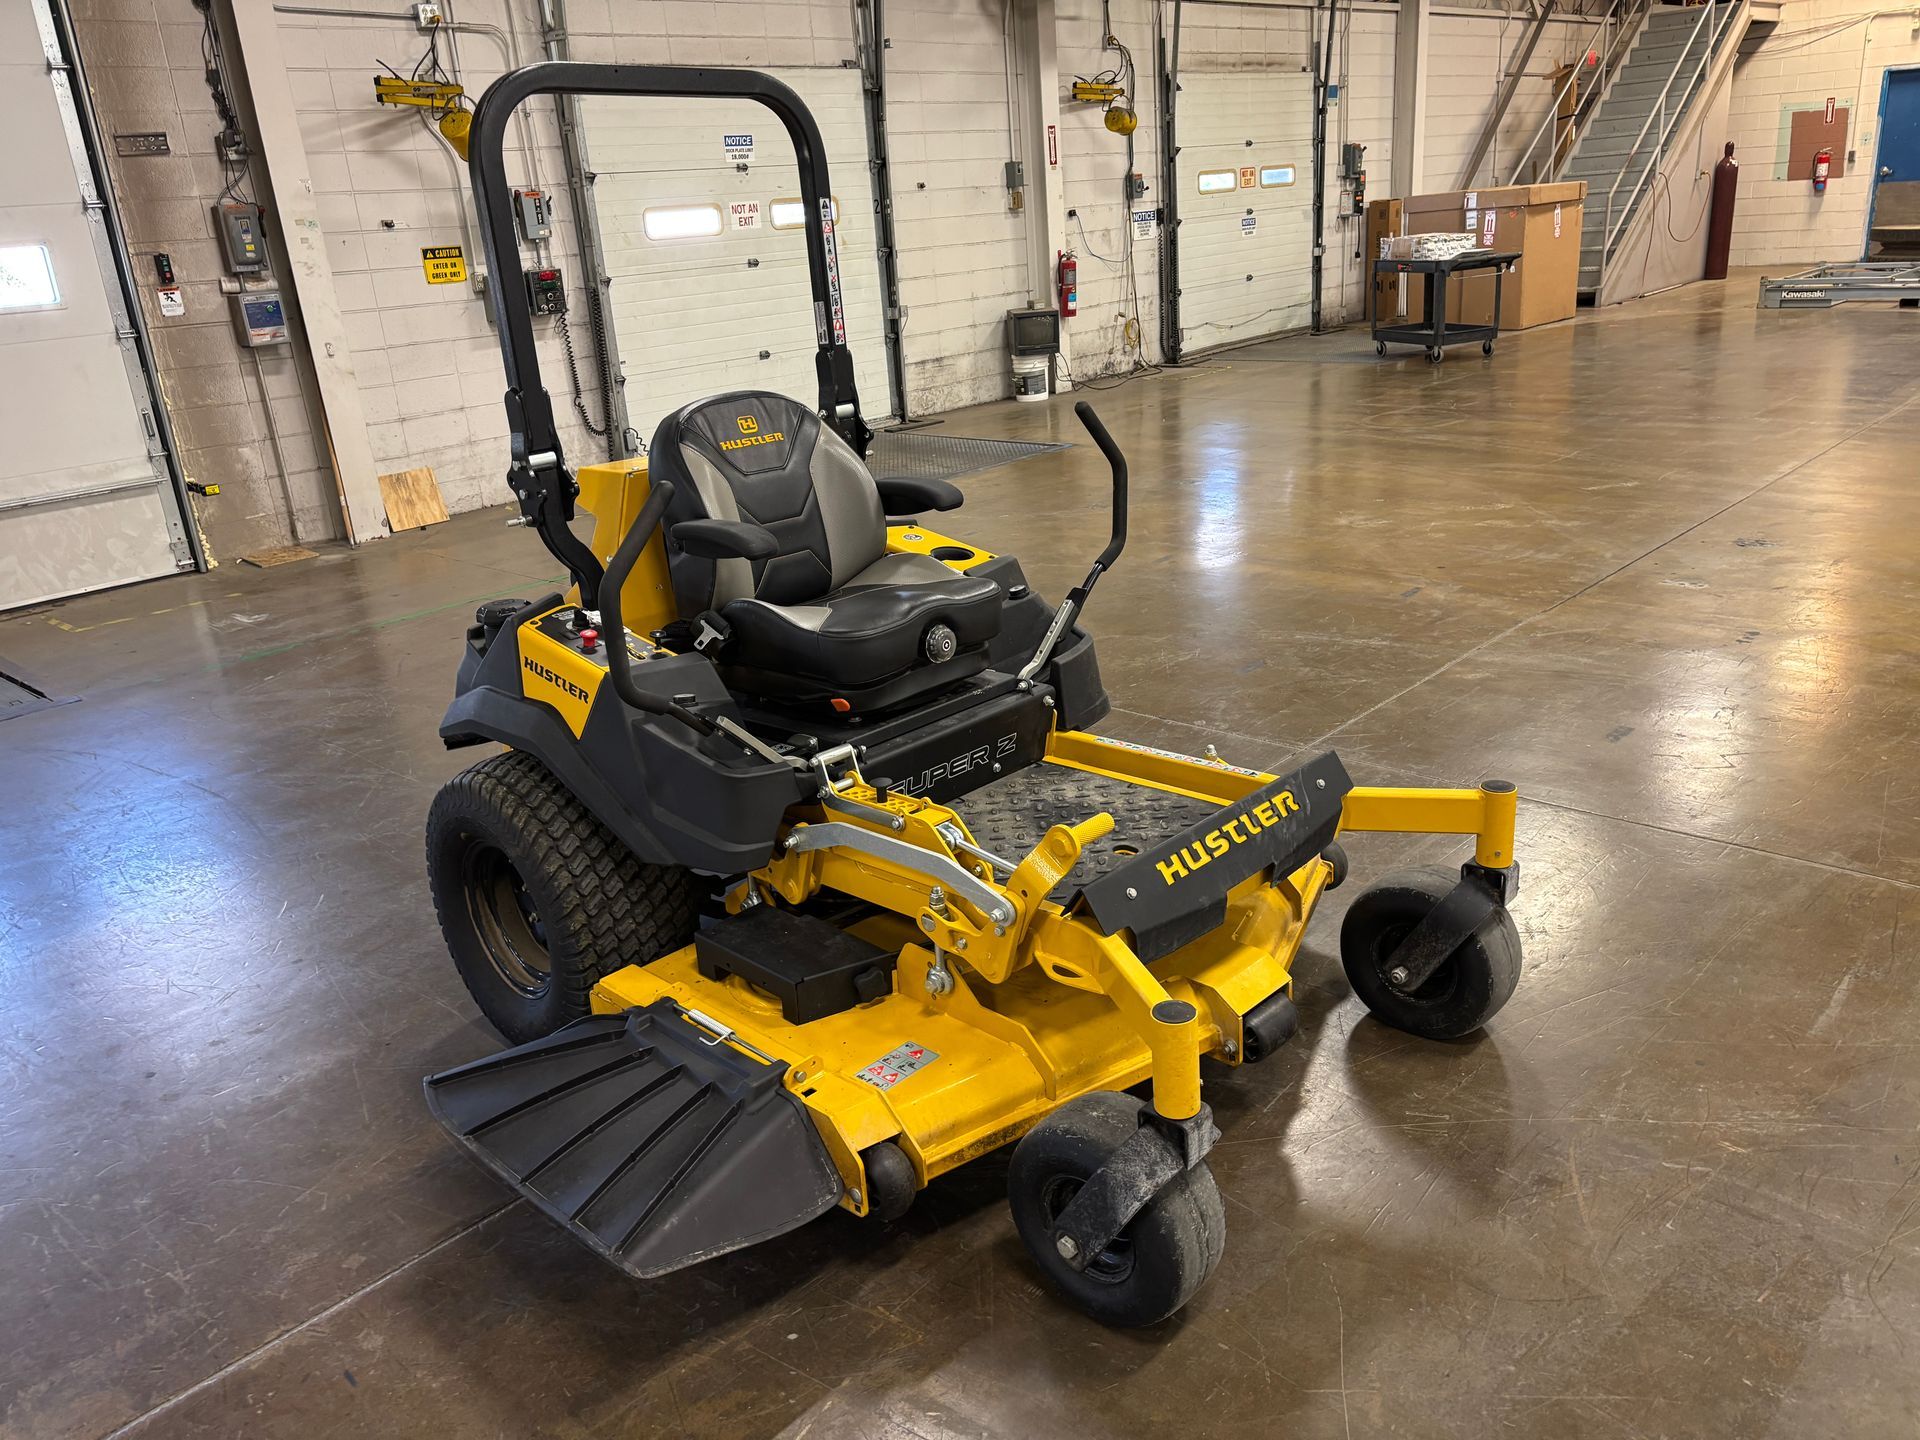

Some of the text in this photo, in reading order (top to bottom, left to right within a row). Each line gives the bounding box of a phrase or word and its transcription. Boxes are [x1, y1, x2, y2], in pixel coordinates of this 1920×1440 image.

[725, 136, 752, 145] NOTICE
[731, 203, 758, 215] NOT AN
[874, 199, 881, 214] 2
[738, 216, 754, 227] EXIT
[1133, 211, 1155, 221] NOTICE
[435, 248, 460, 258] CAUTION
[1781, 290, 1826, 298] Kawasaki
[739, 417, 757, 431] H
[720, 432, 784, 451] HUSTLER
[524, 656, 589, 704] HUSTLER
[997, 732, 1017, 758] Z
[1155, 790, 1300, 886] HUSTLER
